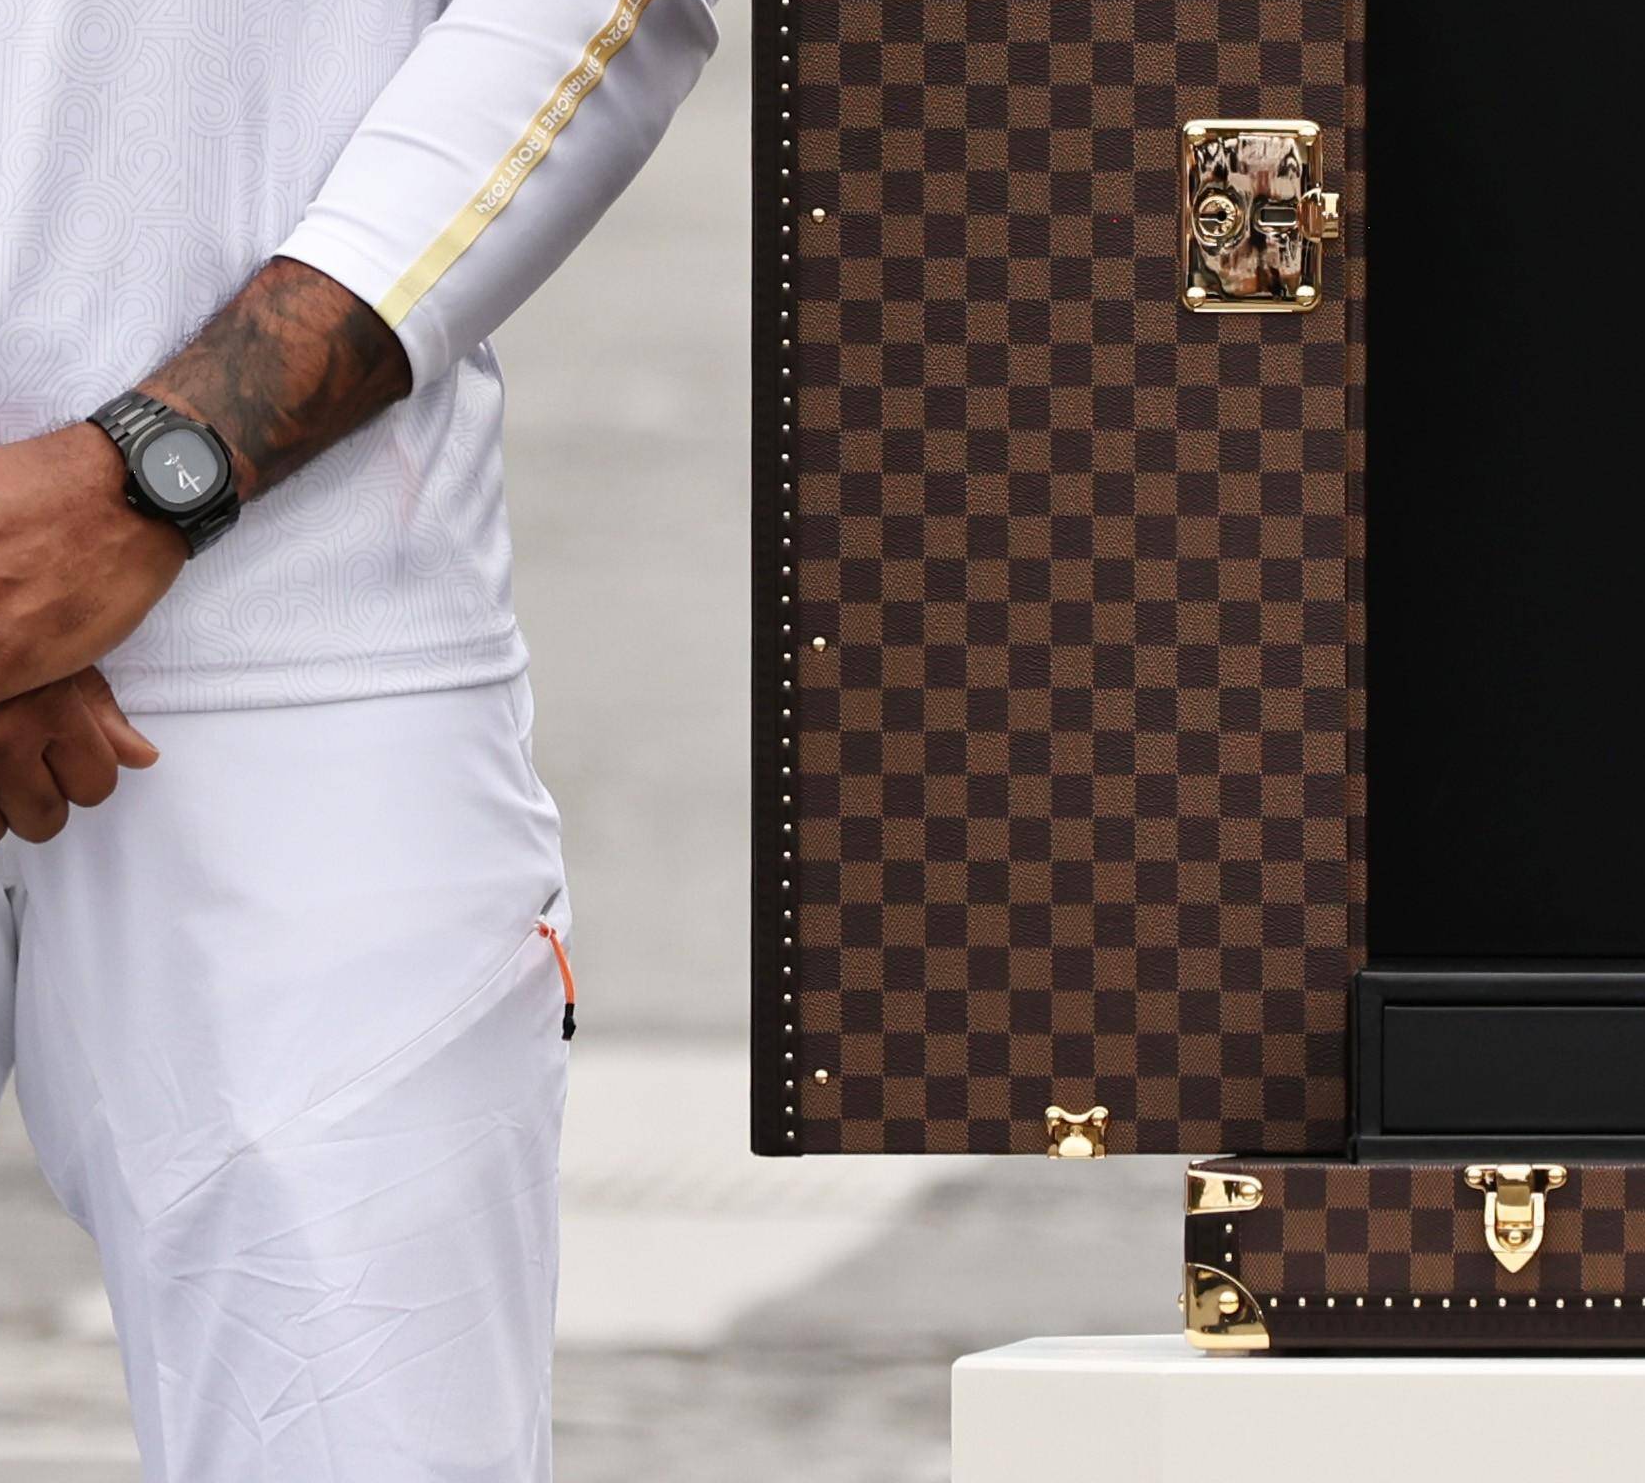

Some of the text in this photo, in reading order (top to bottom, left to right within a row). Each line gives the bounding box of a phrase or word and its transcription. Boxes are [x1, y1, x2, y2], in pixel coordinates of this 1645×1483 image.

[601, 6, 633, 48] 2024
[540, 53, 601, 130] DIMANCHE
[503, 137, 543, 182] AOUT
[474, 175, 510, 215] 2024
